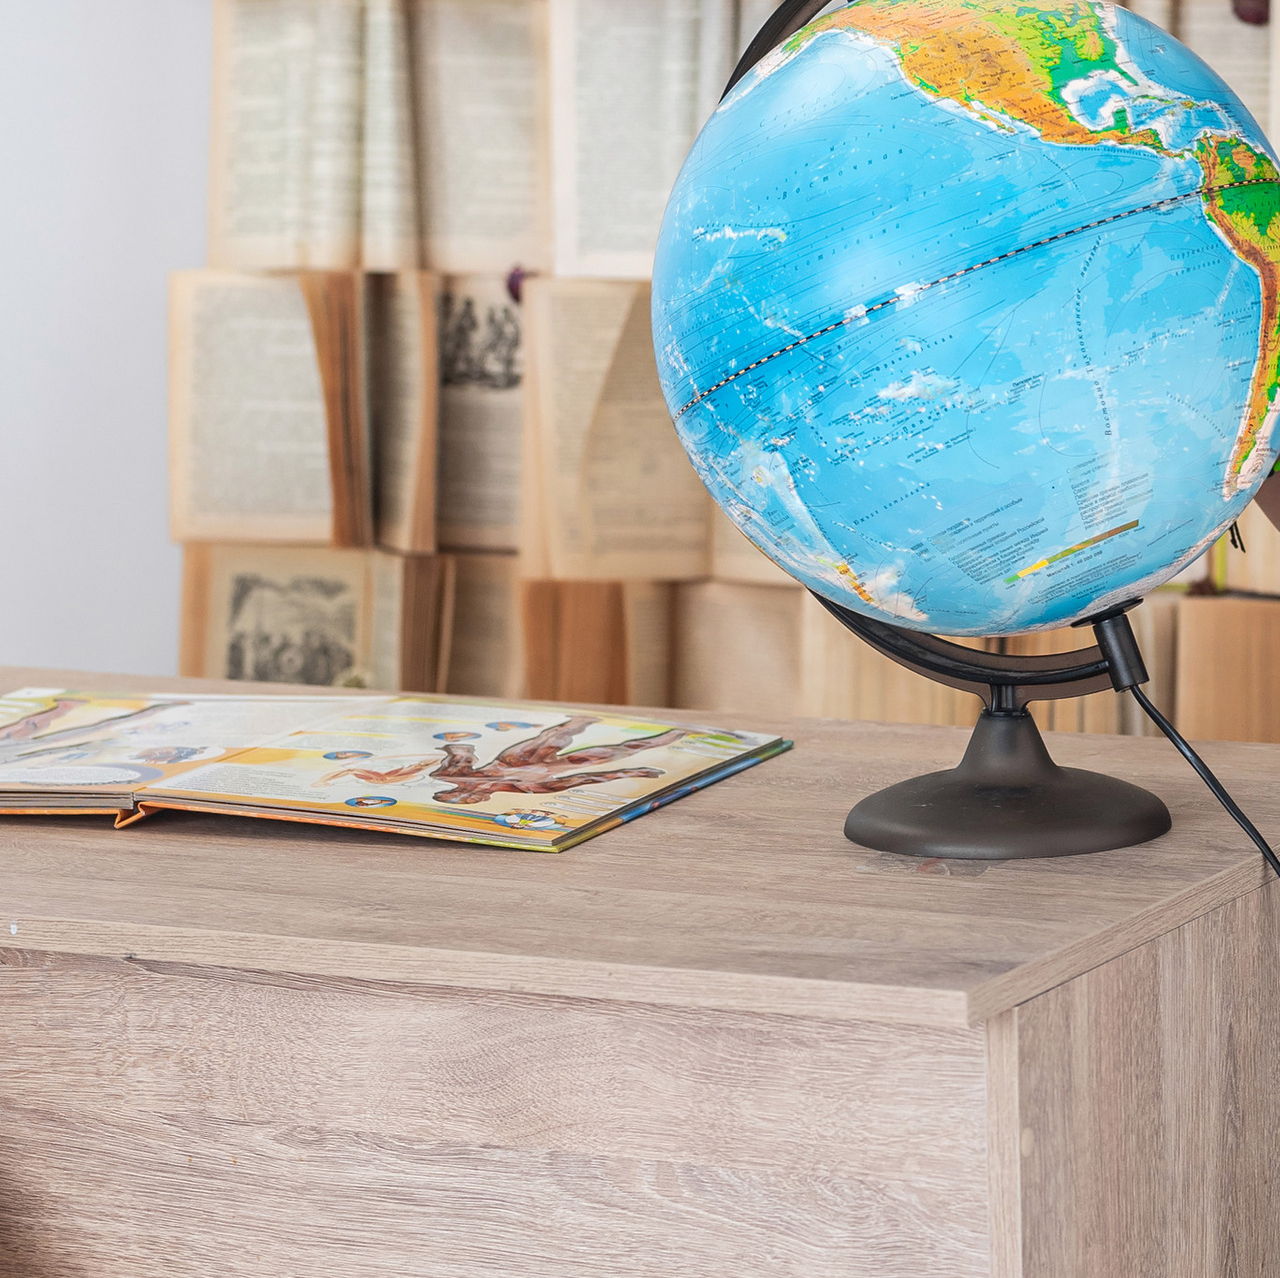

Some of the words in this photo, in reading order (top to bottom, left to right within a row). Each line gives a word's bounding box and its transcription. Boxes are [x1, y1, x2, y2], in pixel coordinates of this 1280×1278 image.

[1004, 498, 1023, 509] особым
[1017, 517, 1045, 533] Российской
[1030, 527, 1048, 539] Индией
[1046, 565, 1070, 578] Масштаб
